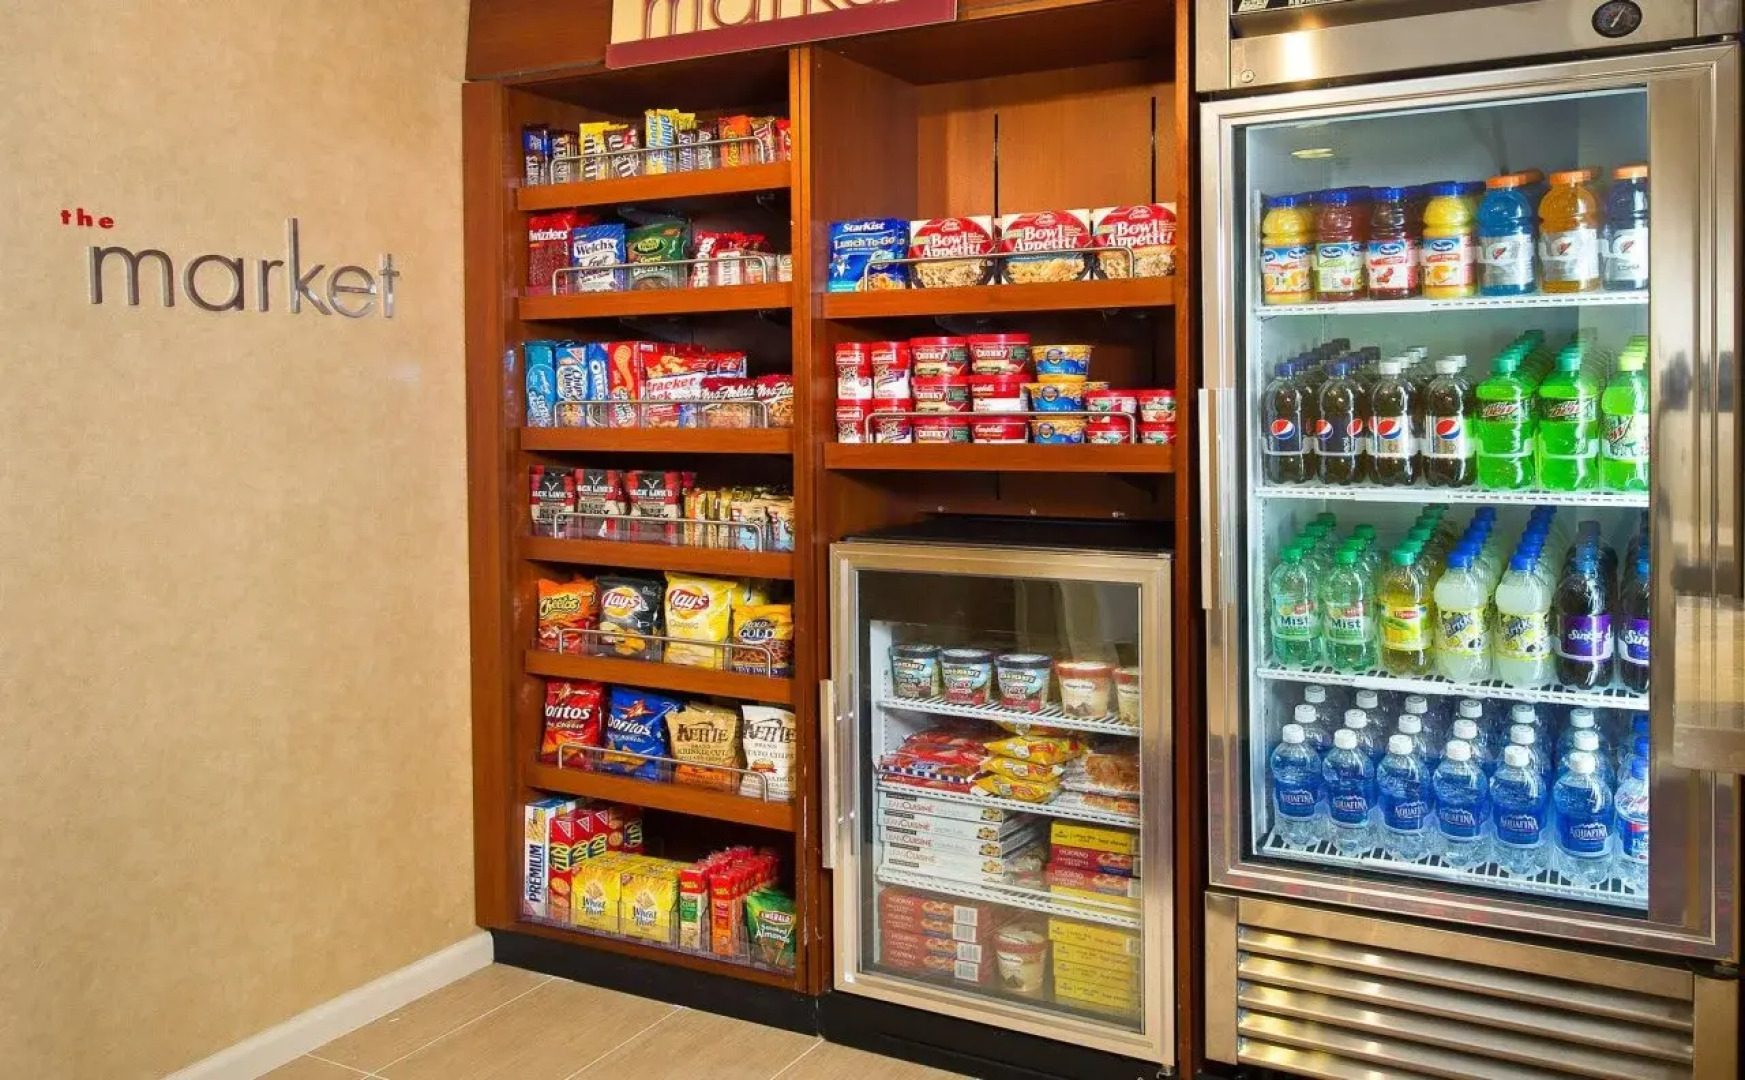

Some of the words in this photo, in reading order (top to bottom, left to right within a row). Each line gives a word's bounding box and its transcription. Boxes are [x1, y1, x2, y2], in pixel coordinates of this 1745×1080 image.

[60, 207, 115, 230] the
[843, 220, 886, 233] StarKist
[1023, 224, 1063, 241] Bowl
[1116, 218, 1159, 237] Bowl
[575, 239, 615, 255] Welch's
[833, 239, 865, 250] Lunch
[929, 231, 968, 248] Bowl
[88, 217, 401, 319] market
[605, 591, 640, 610] Lay's
[671, 589, 710, 609] Lay's
[1280, 615, 1309, 627] Mist
[1331, 618, 1362, 629] Mist
[739, 628, 774, 639] GOLD
[528, 843, 543, 903] PREMIUM
